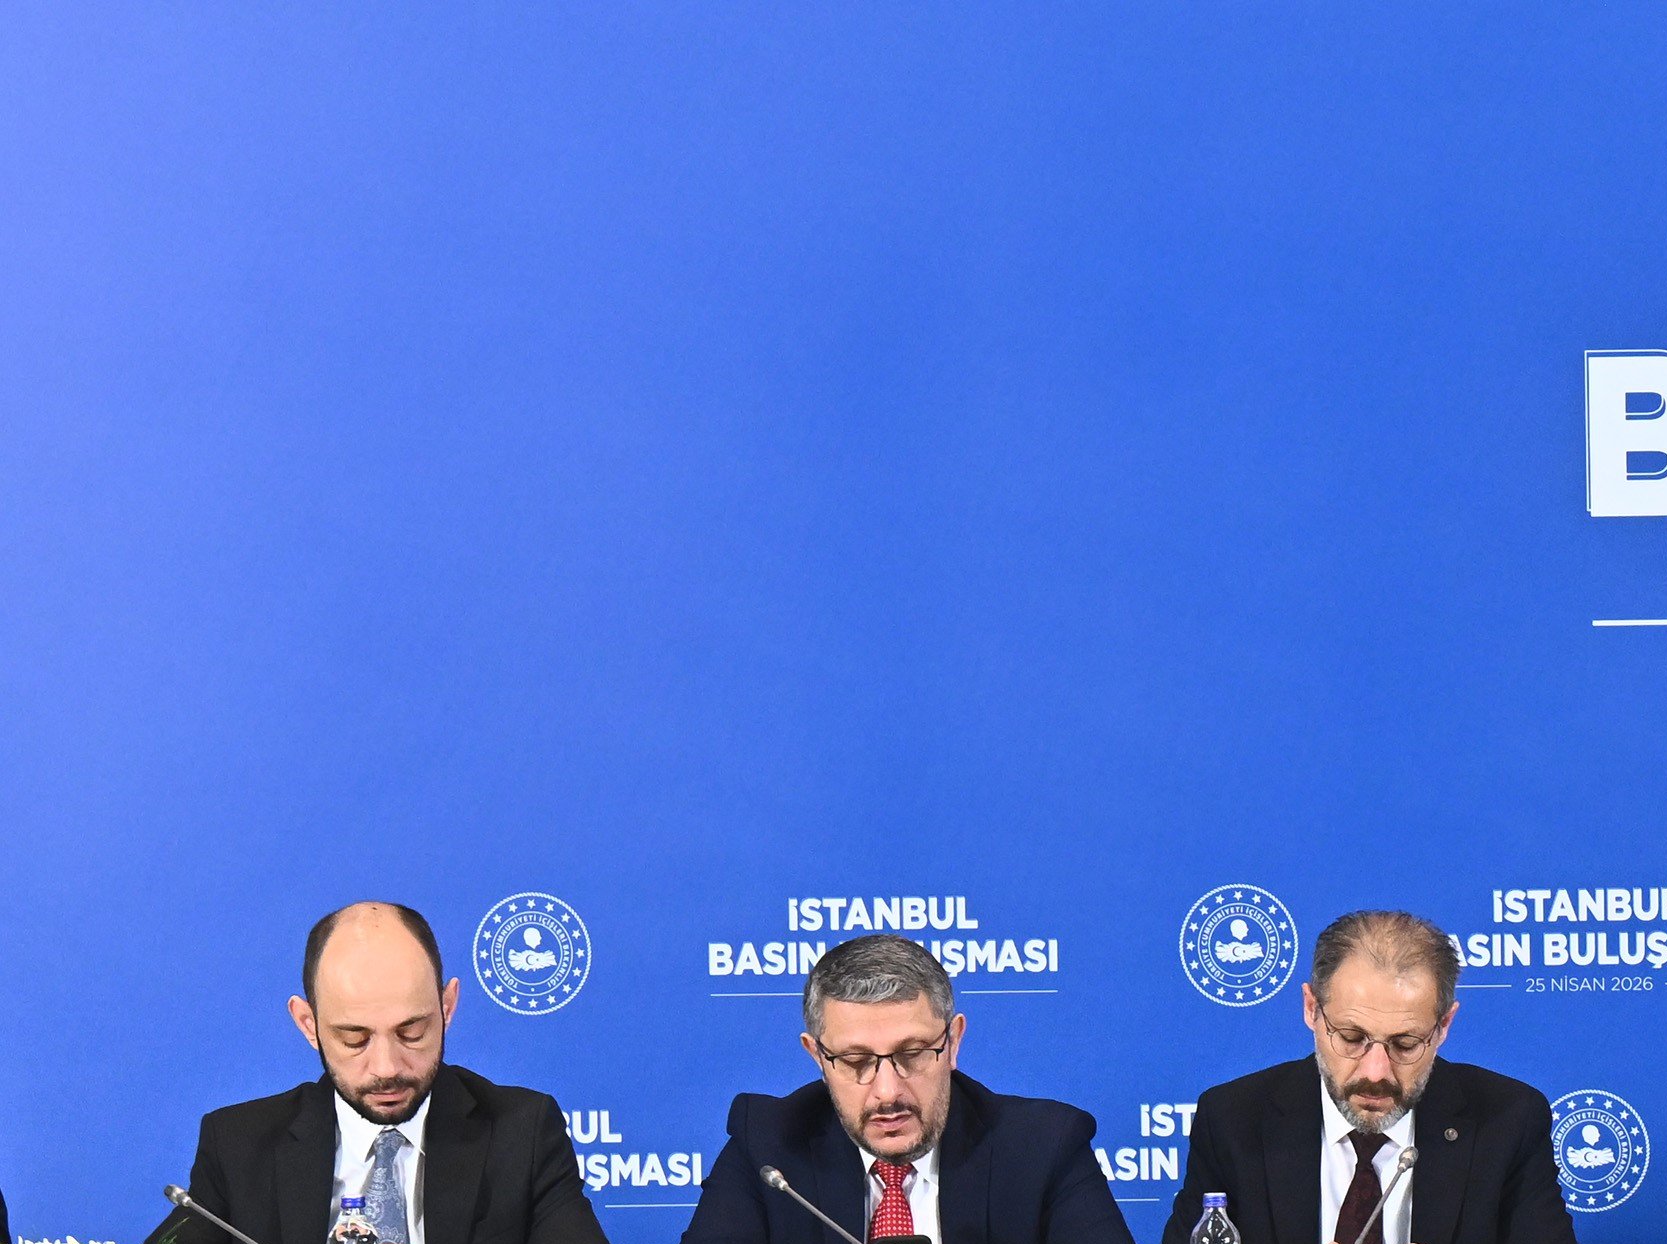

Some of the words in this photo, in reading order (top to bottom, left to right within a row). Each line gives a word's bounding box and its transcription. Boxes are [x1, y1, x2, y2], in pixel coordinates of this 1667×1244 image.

[788, 896, 979, 932] İSTANBUL
[708, 941, 827, 976] BASIN
[920, 939, 1059, 978] ŞMASI
[1525, 978, 1546, 993] 25
[1551, 975, 1605, 992] NİSAN
[1611, 976, 1654, 991] 2026
[576, 1152, 702, 1192] ŞMASI
